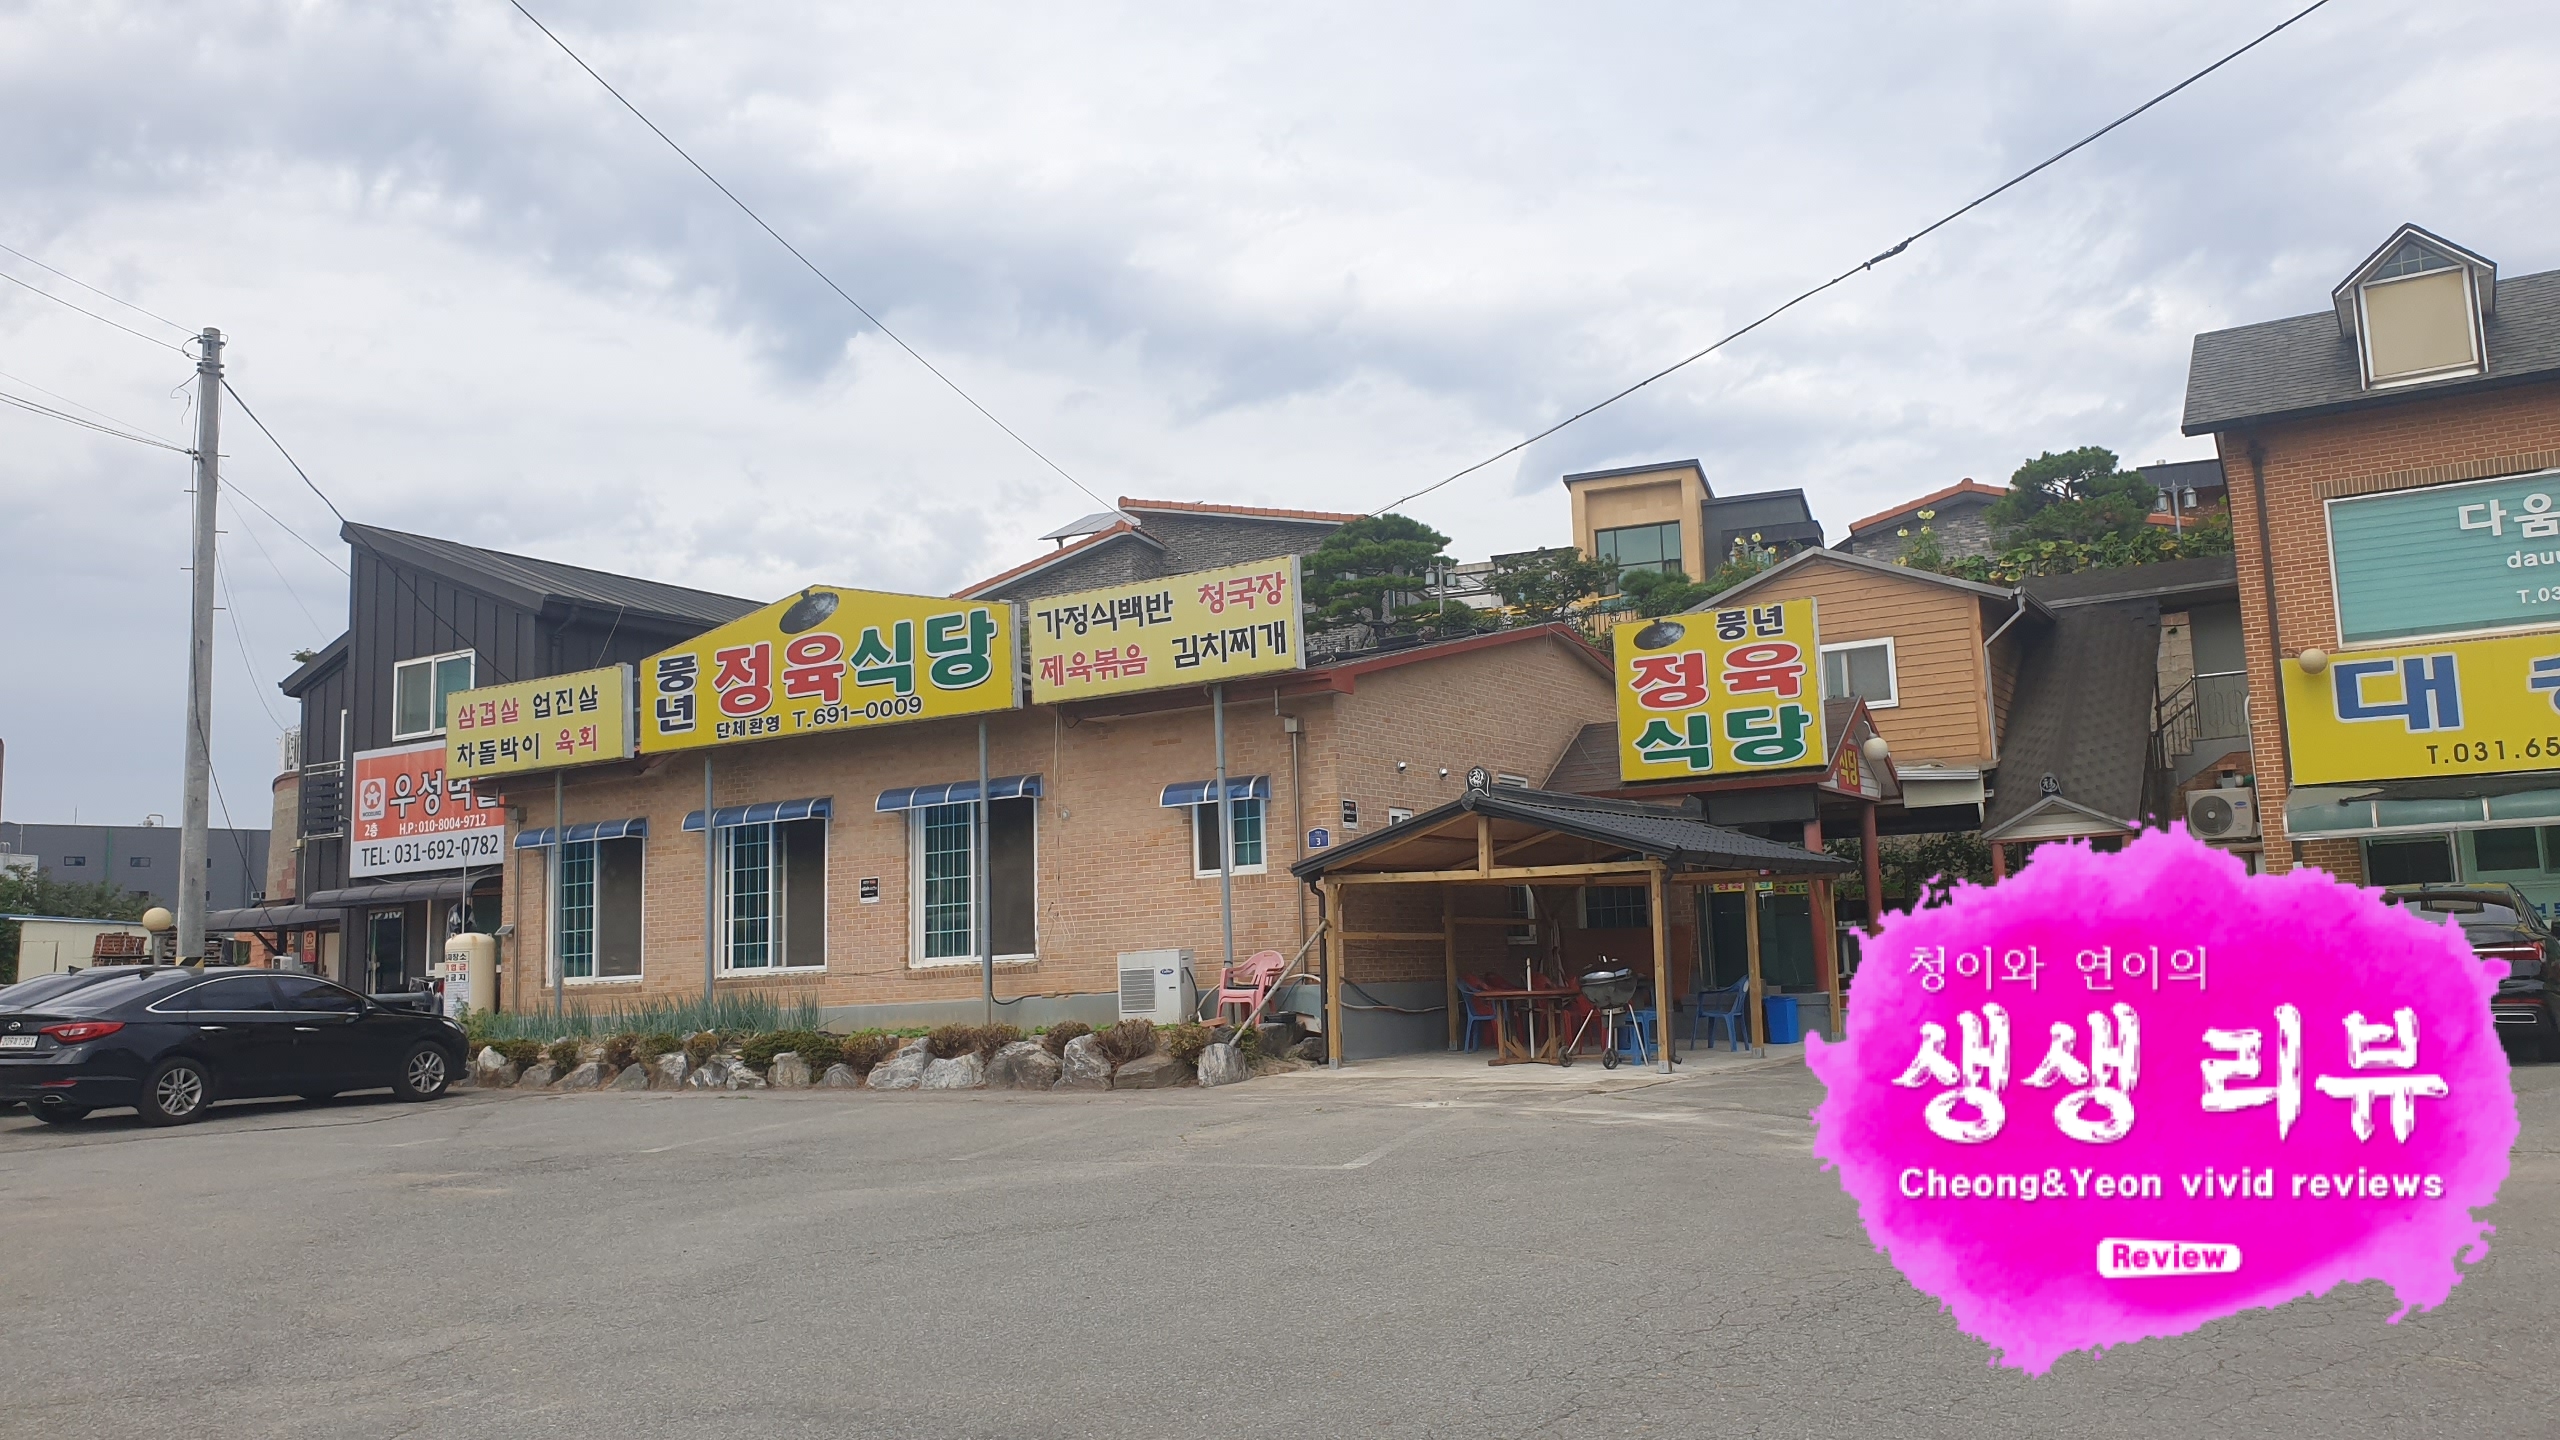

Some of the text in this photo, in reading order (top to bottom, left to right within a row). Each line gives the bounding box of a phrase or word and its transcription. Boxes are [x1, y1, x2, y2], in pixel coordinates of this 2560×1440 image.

[1037, 571, 1286, 639] 가정식백반 청국장
[1716, 604, 1785, 641] 풍년
[712, 607, 997, 717] 정육식당
[1040, 620, 1287, 687] 제육볶음 김치찌개
[1629, 642, 1807, 711] 정육
[457, 684, 598, 730] 삼겹살 업진살
[656, 653, 699, 736] 풍년
[716, 696, 922, 740] 단체환영 T.691-0009
[1632, 703, 1812, 771] 식당
[457, 724, 597, 768] 차돌박이 육회
[361, 834, 498, 867] TEL: 031-692-0782
[364, 823, 378, 837] 2층
[1315, 837, 1321, 846] 3
